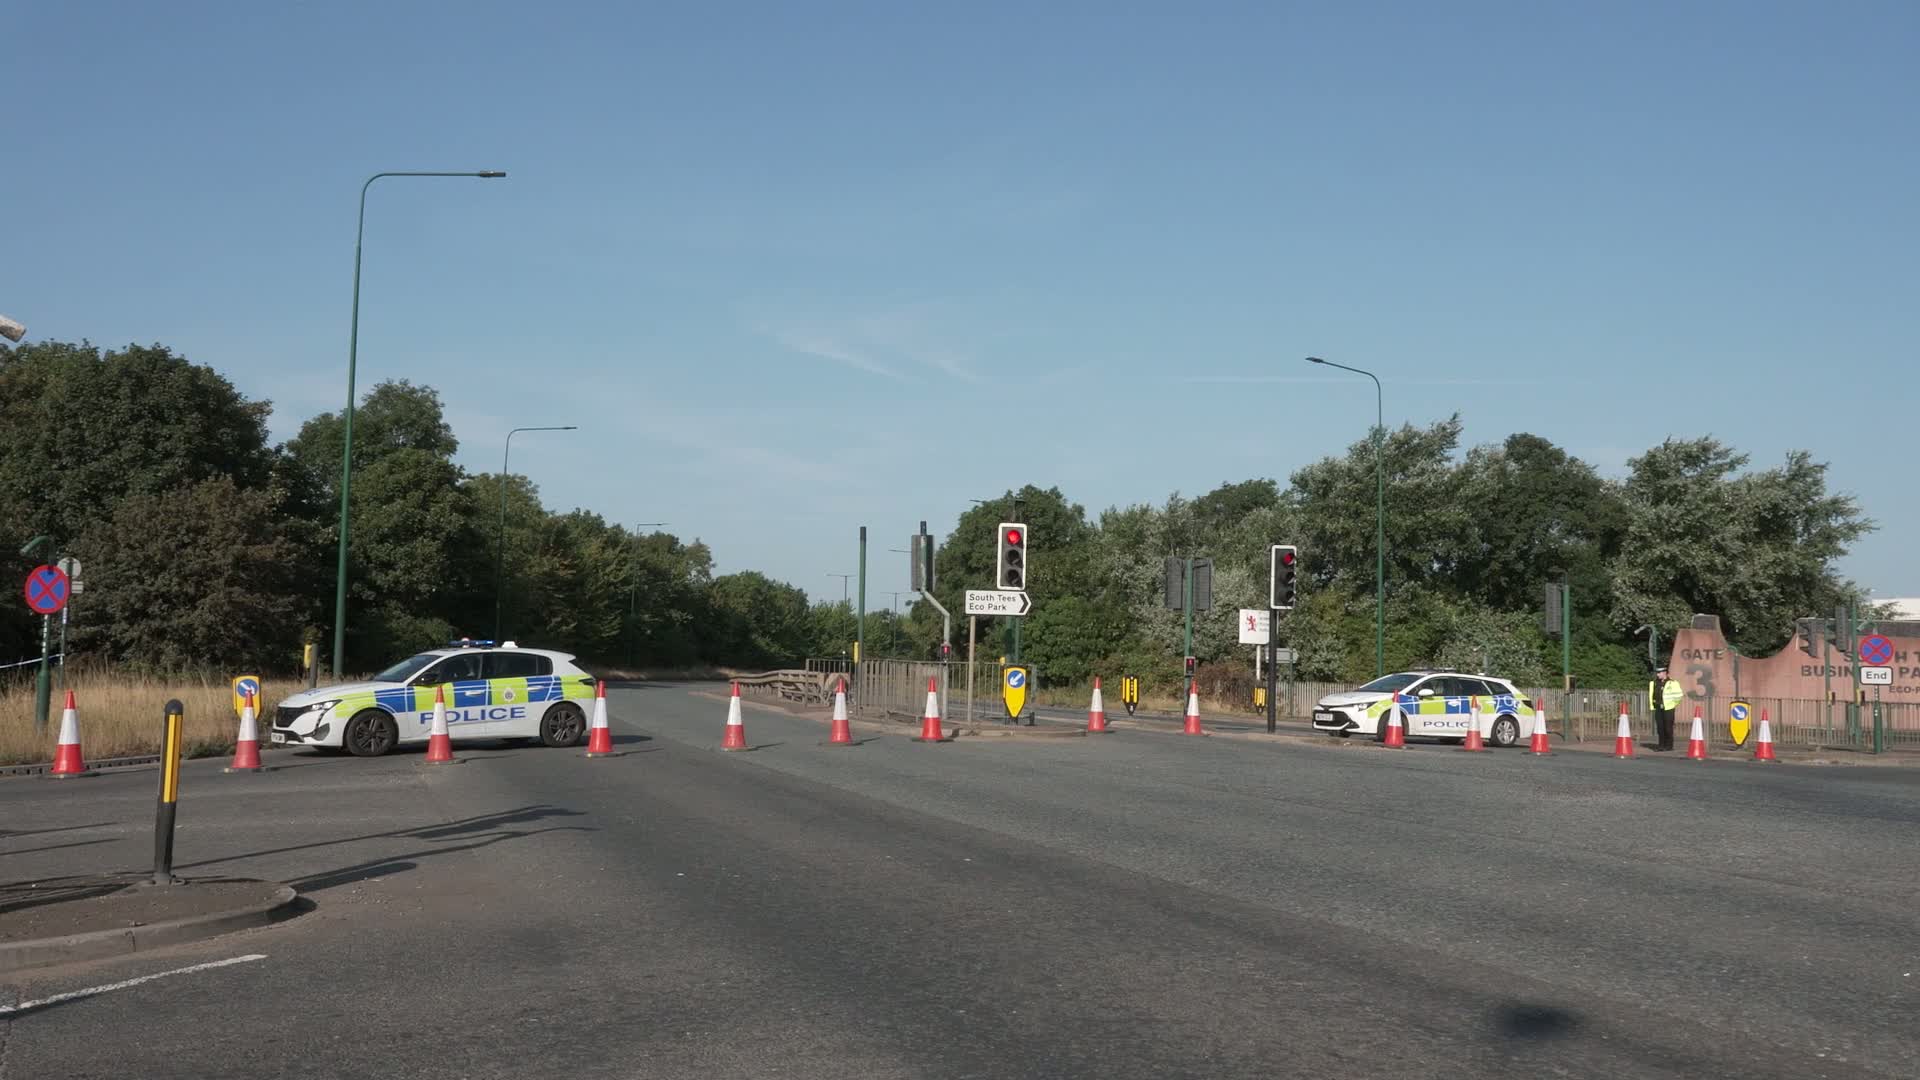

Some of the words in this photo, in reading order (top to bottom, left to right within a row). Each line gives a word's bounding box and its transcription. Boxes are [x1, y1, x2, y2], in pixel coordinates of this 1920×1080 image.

[969, 593, 995, 602] South
[997, 594, 1016, 602] Tees
[969, 603, 985, 611] Eco
[988, 603, 1007, 611] Park
[1680, 648, 1724, 660] GATE
[1865, 671, 1887, 680] End
[1685, 664, 1716, 701] 3
[420, 707, 526, 725] POLICE
